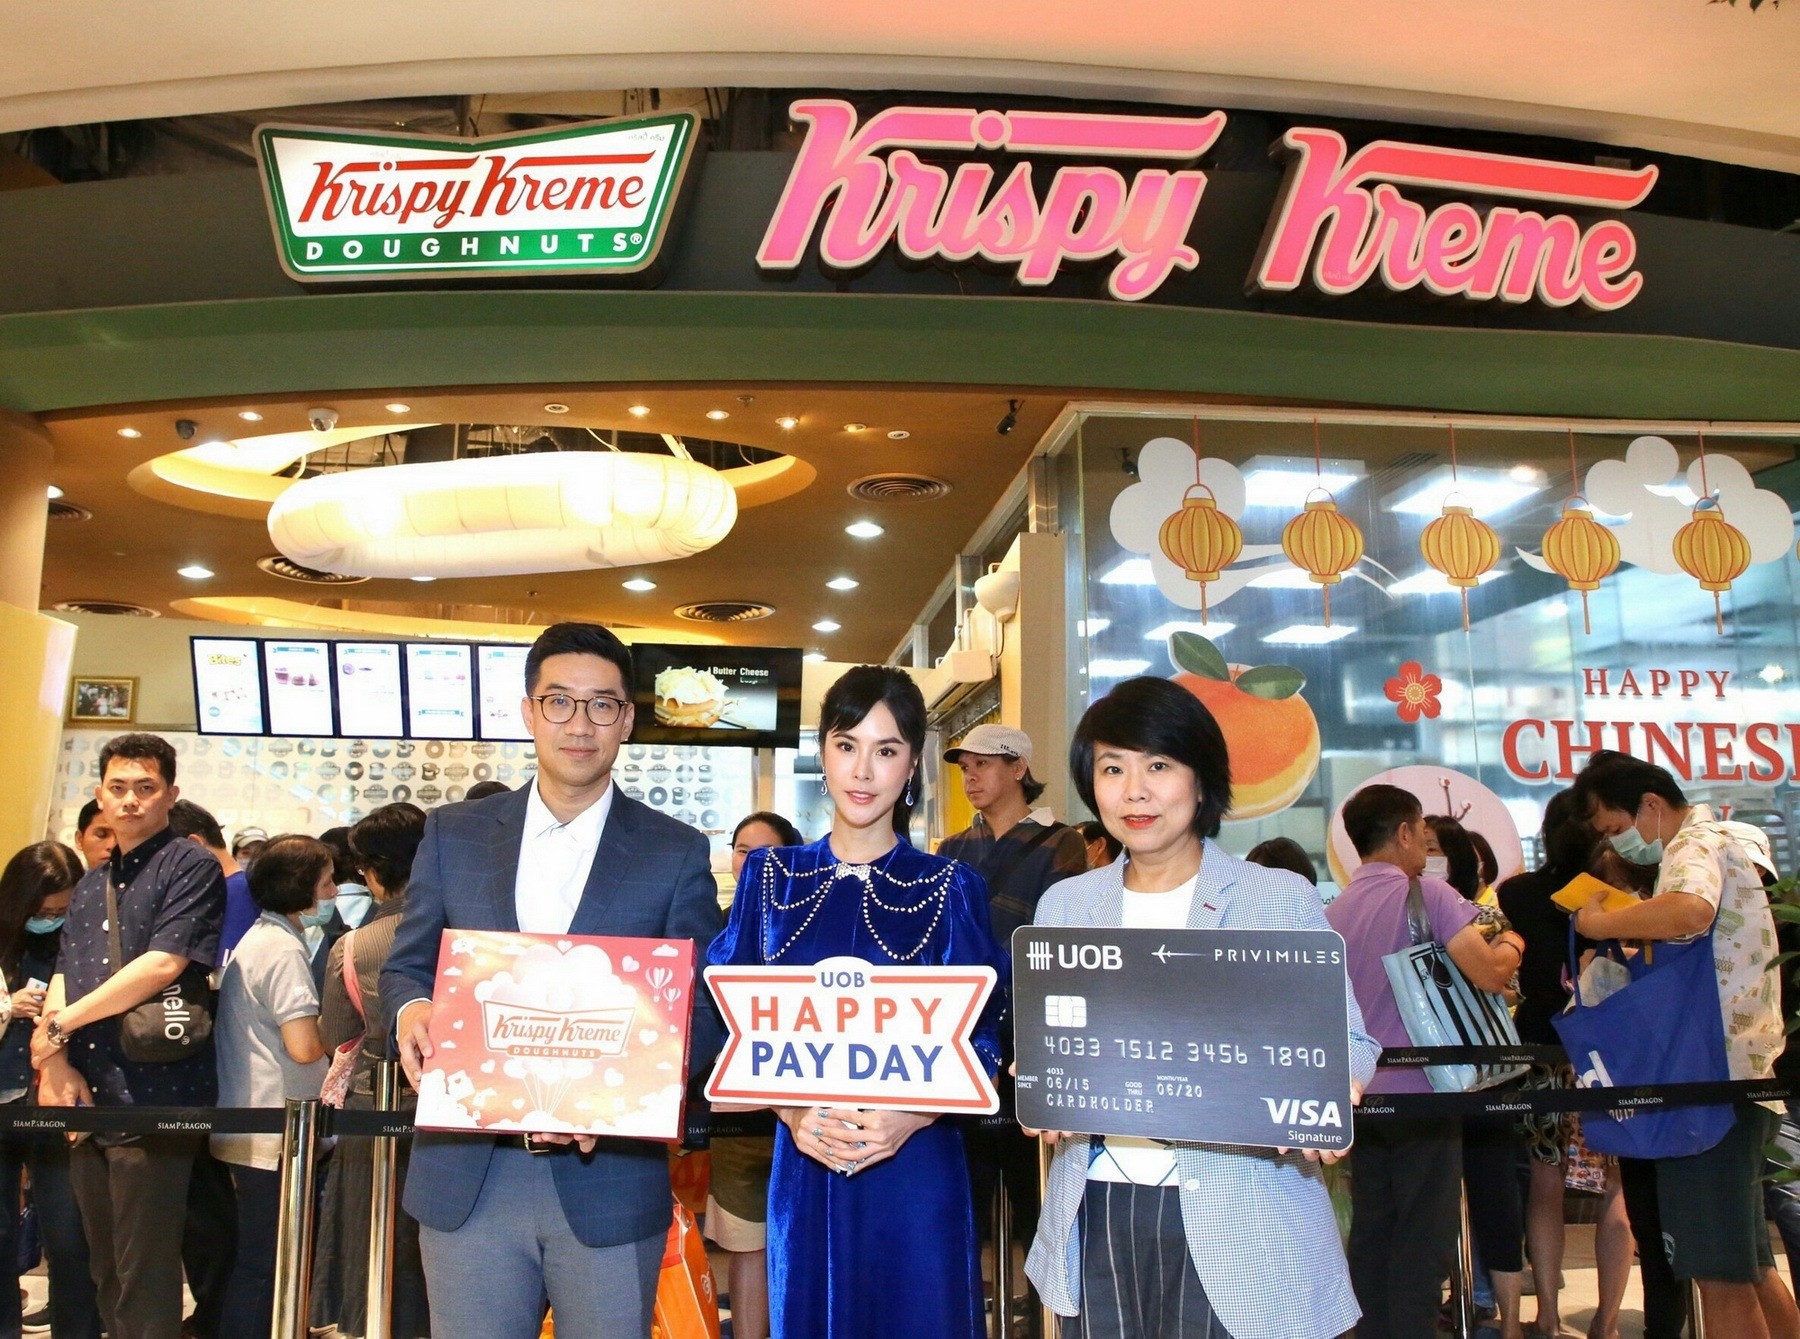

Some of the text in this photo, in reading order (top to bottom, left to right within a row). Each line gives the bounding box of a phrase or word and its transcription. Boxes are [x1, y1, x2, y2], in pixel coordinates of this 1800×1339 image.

[297, 150, 656, 229] Krispy Kreme
[755, 98, 1660, 311] Krispy Kreme
[713, 666, 737, 676] Butter
[739, 667, 769, 677] Cheese
[1582, 668, 1731, 698] HAPPY
[1058, 944, 1341, 971] UOB PRIVIMILES
[820, 971, 865, 988] UOB
[751, 996, 943, 1035] HAPPY
[492, 1014, 625, 1044] Krispy Kreme
[513, 1047, 596, 1058] DOUGHNUTS
[751, 1041, 943, 1083] PAY DAY
[1045, 1035, 1327, 1068] 4033 7512 3456 7890
[1046, 1067, 1064, 1076] 4033
[1046, 1077, 1090, 1091] 06/15
[1125, 1081, 1203, 1098] GOOD 06/20
[1127, 1088, 1143, 1096] THRU
[1046, 1093, 1155, 1114] CARDHOLDER
[1260, 1097, 1342, 1128] VISA
[382, 1125, 417, 1133] SIAMPAR
[1288, 1130, 1343, 1145] Signature
